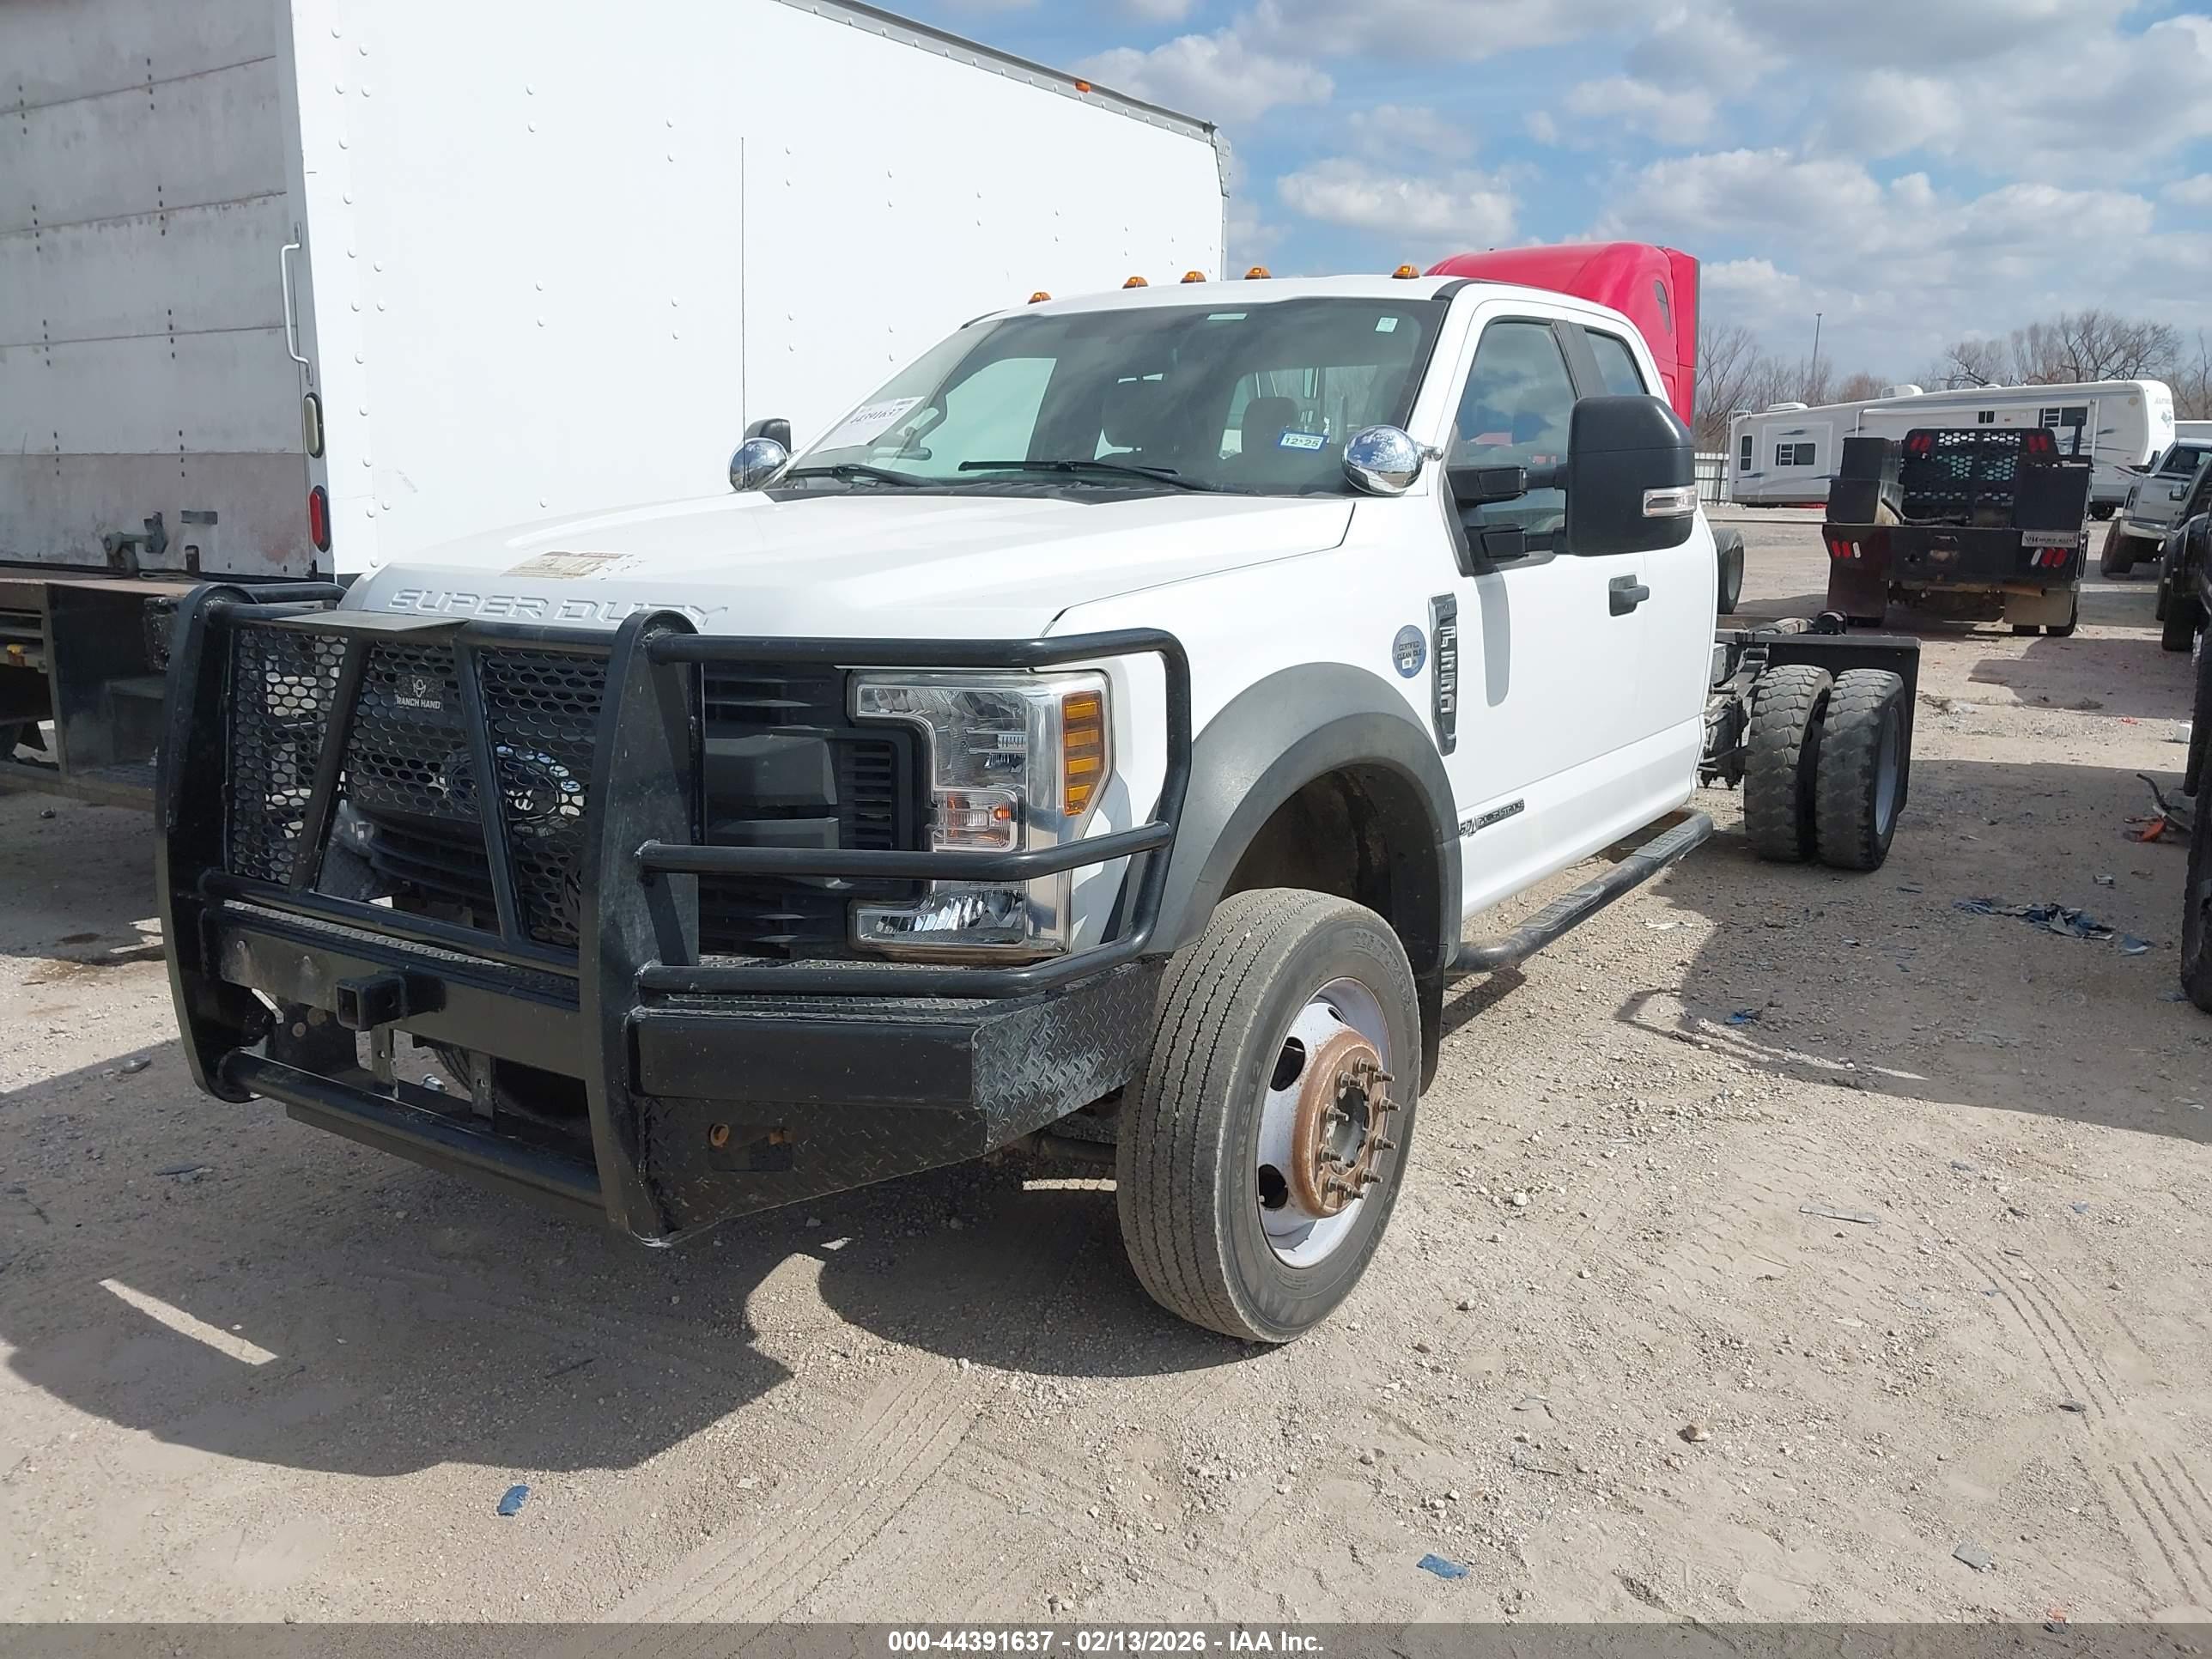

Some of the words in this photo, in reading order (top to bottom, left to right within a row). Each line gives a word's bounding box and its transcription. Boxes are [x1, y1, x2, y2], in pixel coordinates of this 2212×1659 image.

[388, 588, 550, 620] SUPER
[1397, 651, 1412, 659] CLEAN
[396, 694, 420, 708] RANCH
[420, 699, 441, 709] HAND
